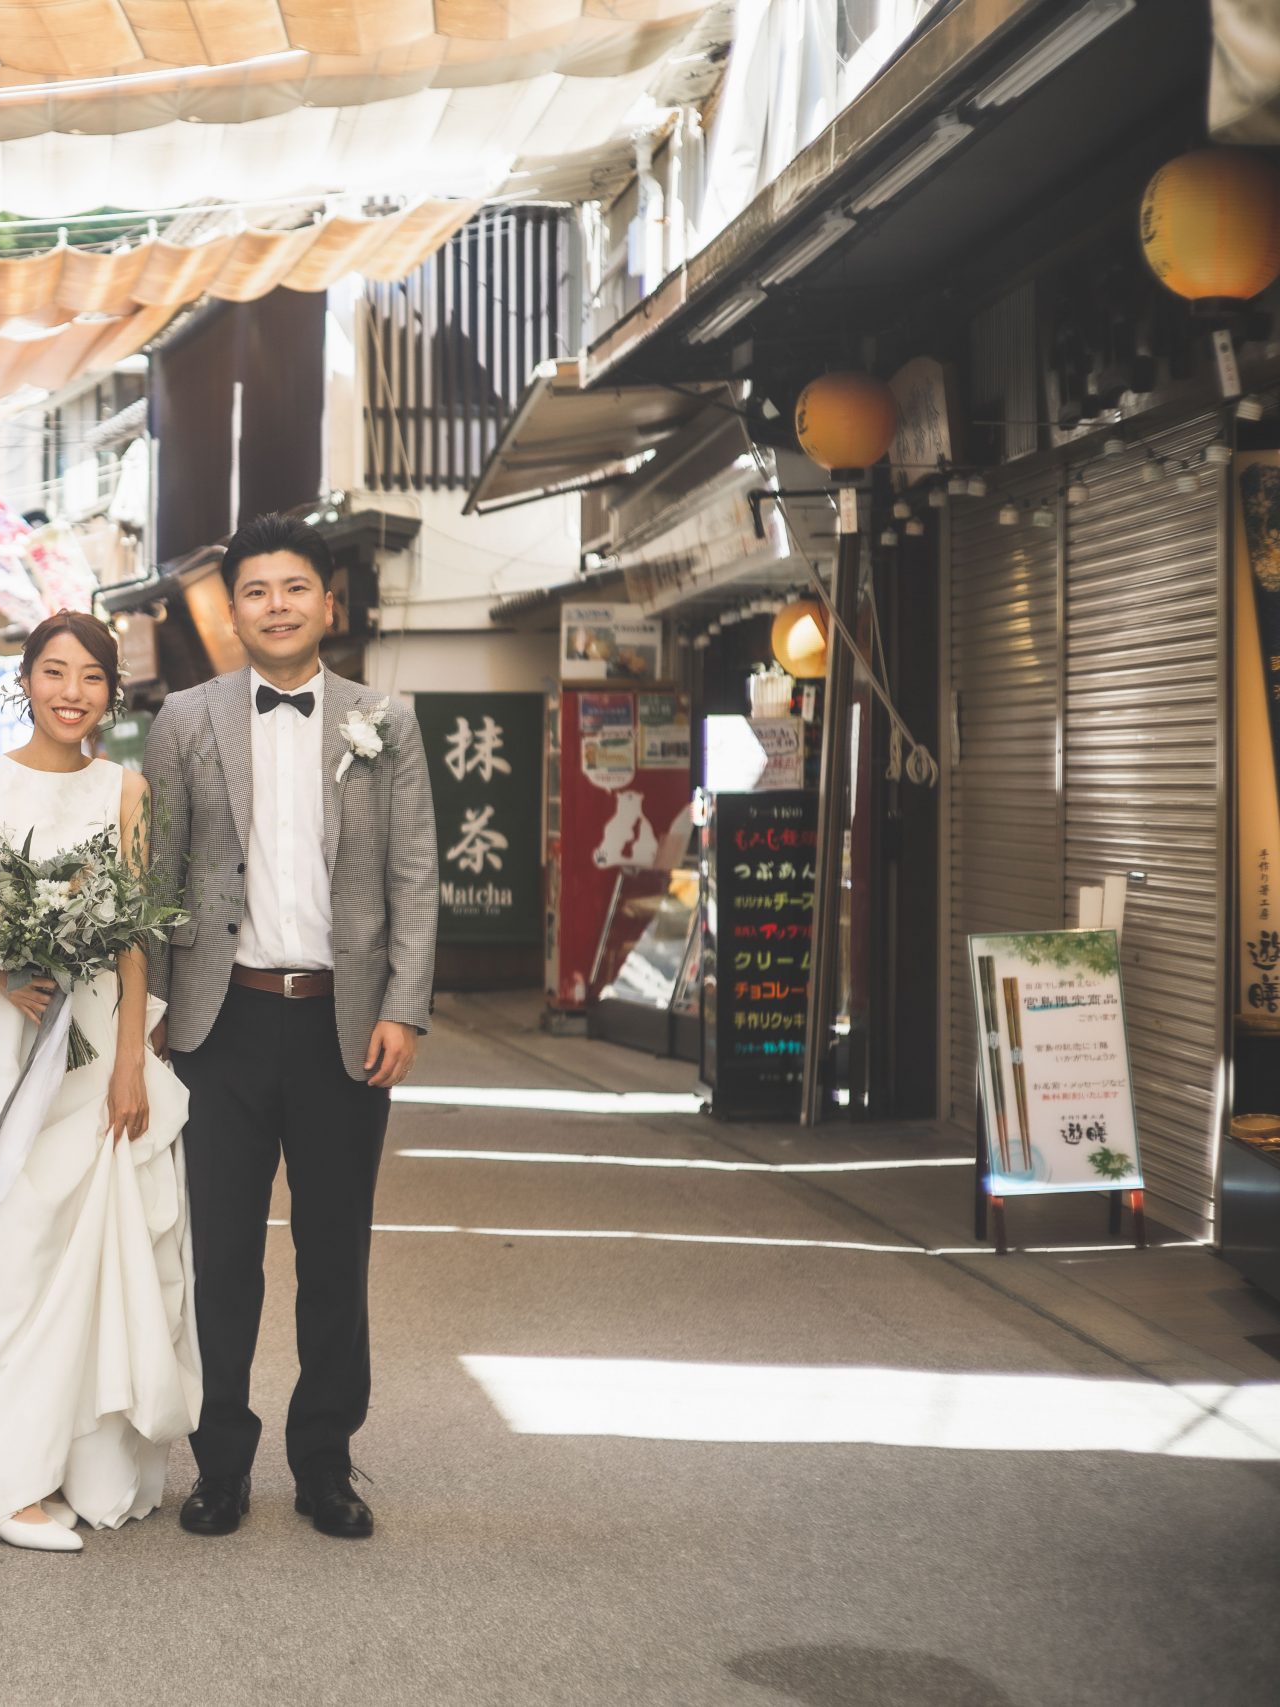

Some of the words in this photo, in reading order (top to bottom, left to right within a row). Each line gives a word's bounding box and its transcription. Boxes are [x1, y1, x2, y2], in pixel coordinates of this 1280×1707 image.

[445, 716, 512, 874] 抹茶
[734, 862, 816, 881] つぶあん
[440, 882, 513, 906] Matcha
[1024, 994, 1117, 1009] 宮島限定商品
